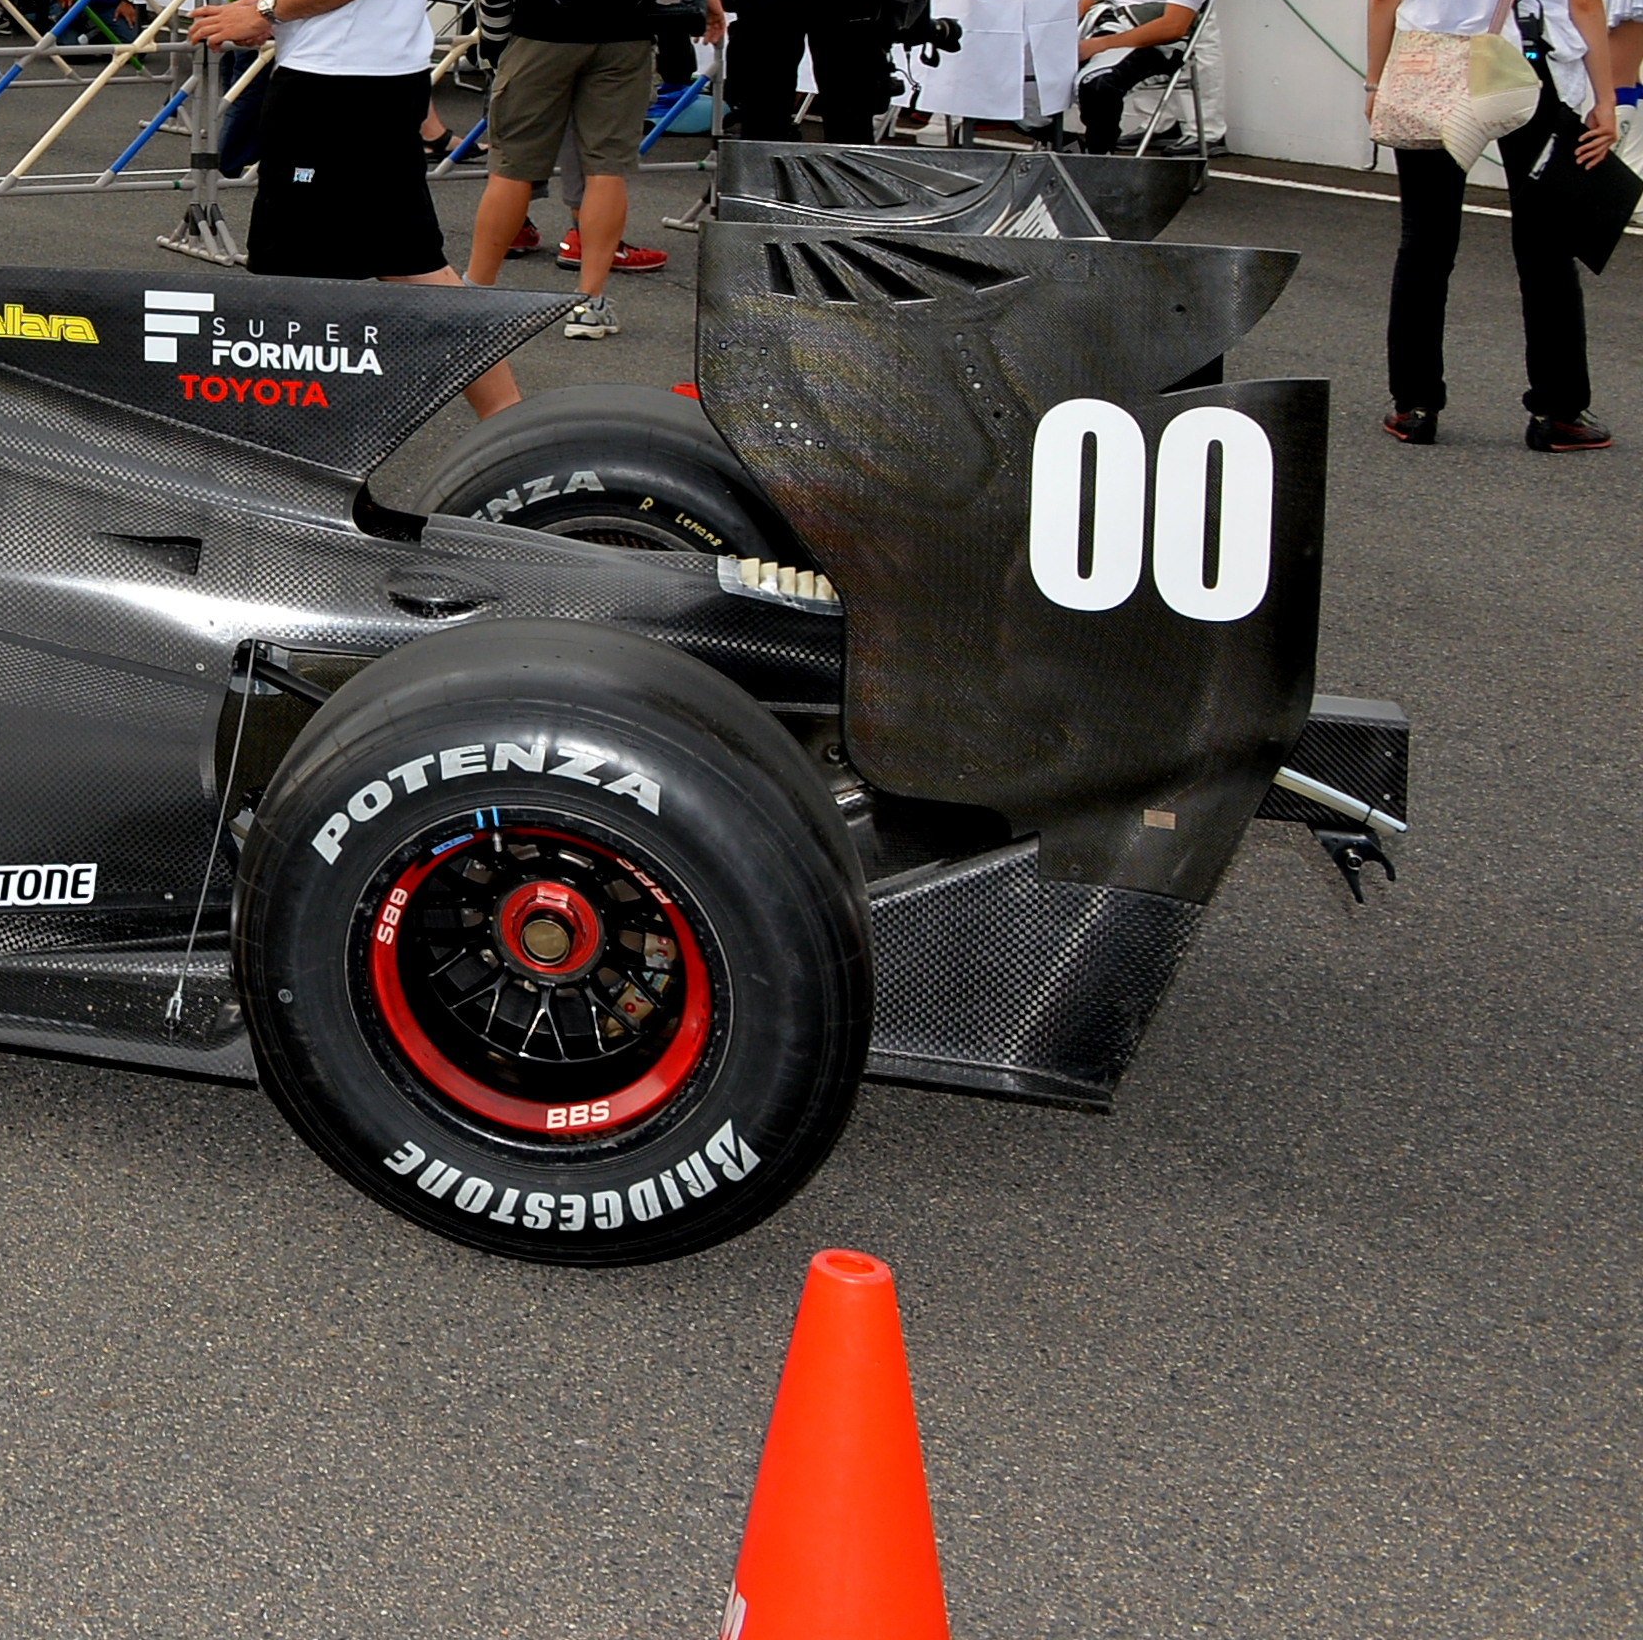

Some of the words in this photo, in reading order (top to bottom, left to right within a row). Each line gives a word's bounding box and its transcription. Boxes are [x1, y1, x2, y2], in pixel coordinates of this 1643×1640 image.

[212, 316, 379, 346] SUPER
[211, 340, 384, 375] FORMULA
[178, 374, 329, 408] TOYOTA
[1030, 397, 1274, 621] 00
[311, 742, 662, 865] POTENZA
[377, 887, 408, 946] BBS
[546, 1100, 610, 1129] BBS
[383, 1119, 761, 1231] BRIDGESTONE
